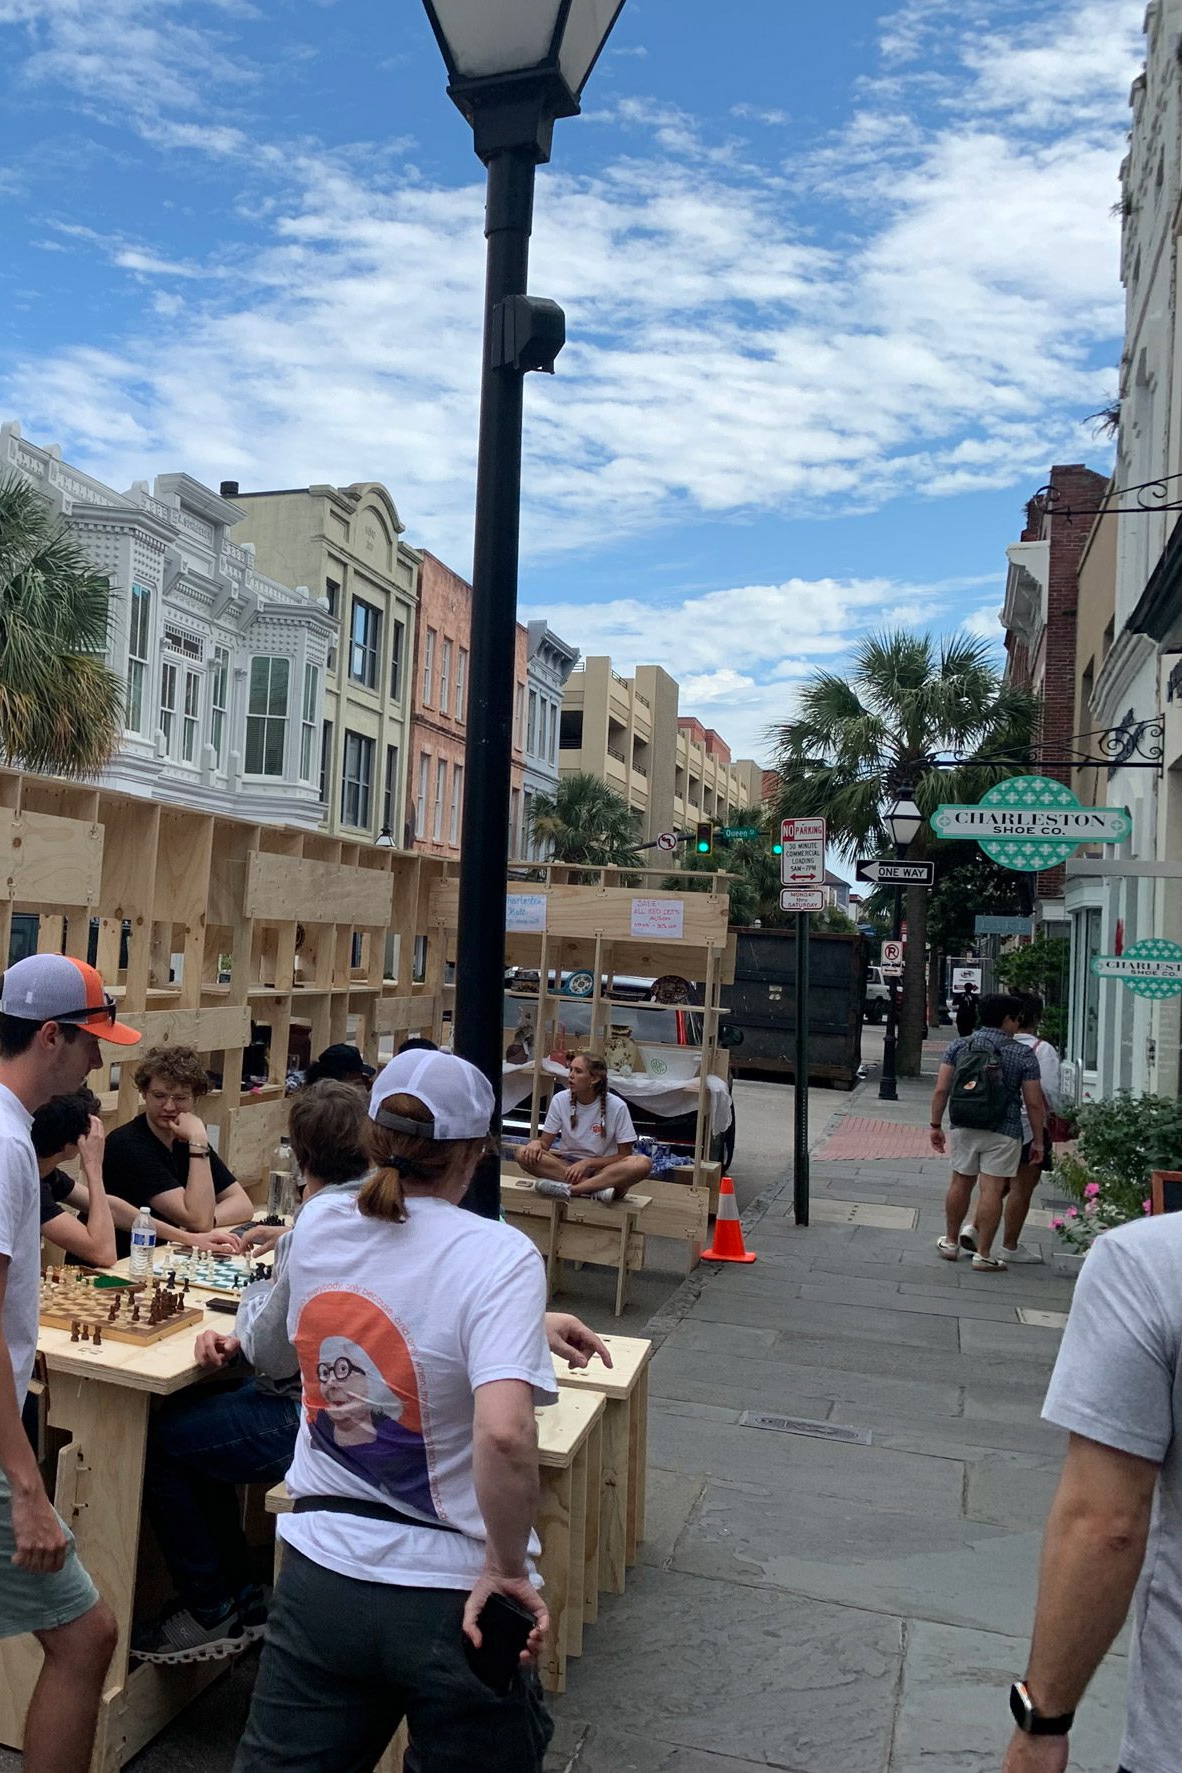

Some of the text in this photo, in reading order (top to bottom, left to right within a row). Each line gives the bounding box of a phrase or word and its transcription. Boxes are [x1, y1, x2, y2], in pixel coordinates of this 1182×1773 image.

[955, 812, 1106, 828] CHARLESTON
[725, 829, 748, 838] Queen
[783, 825, 822, 837] NO PARKING
[993, 826, 1065, 836] SHOE CO.
[878, 867, 925, 878] ONE WAY
[345, 1283, 361, 1294] only
[394, 1316, 410, 1337] and
[407, 1337, 419, 1357] only
[431, 1475, 449, 1520] everybod
